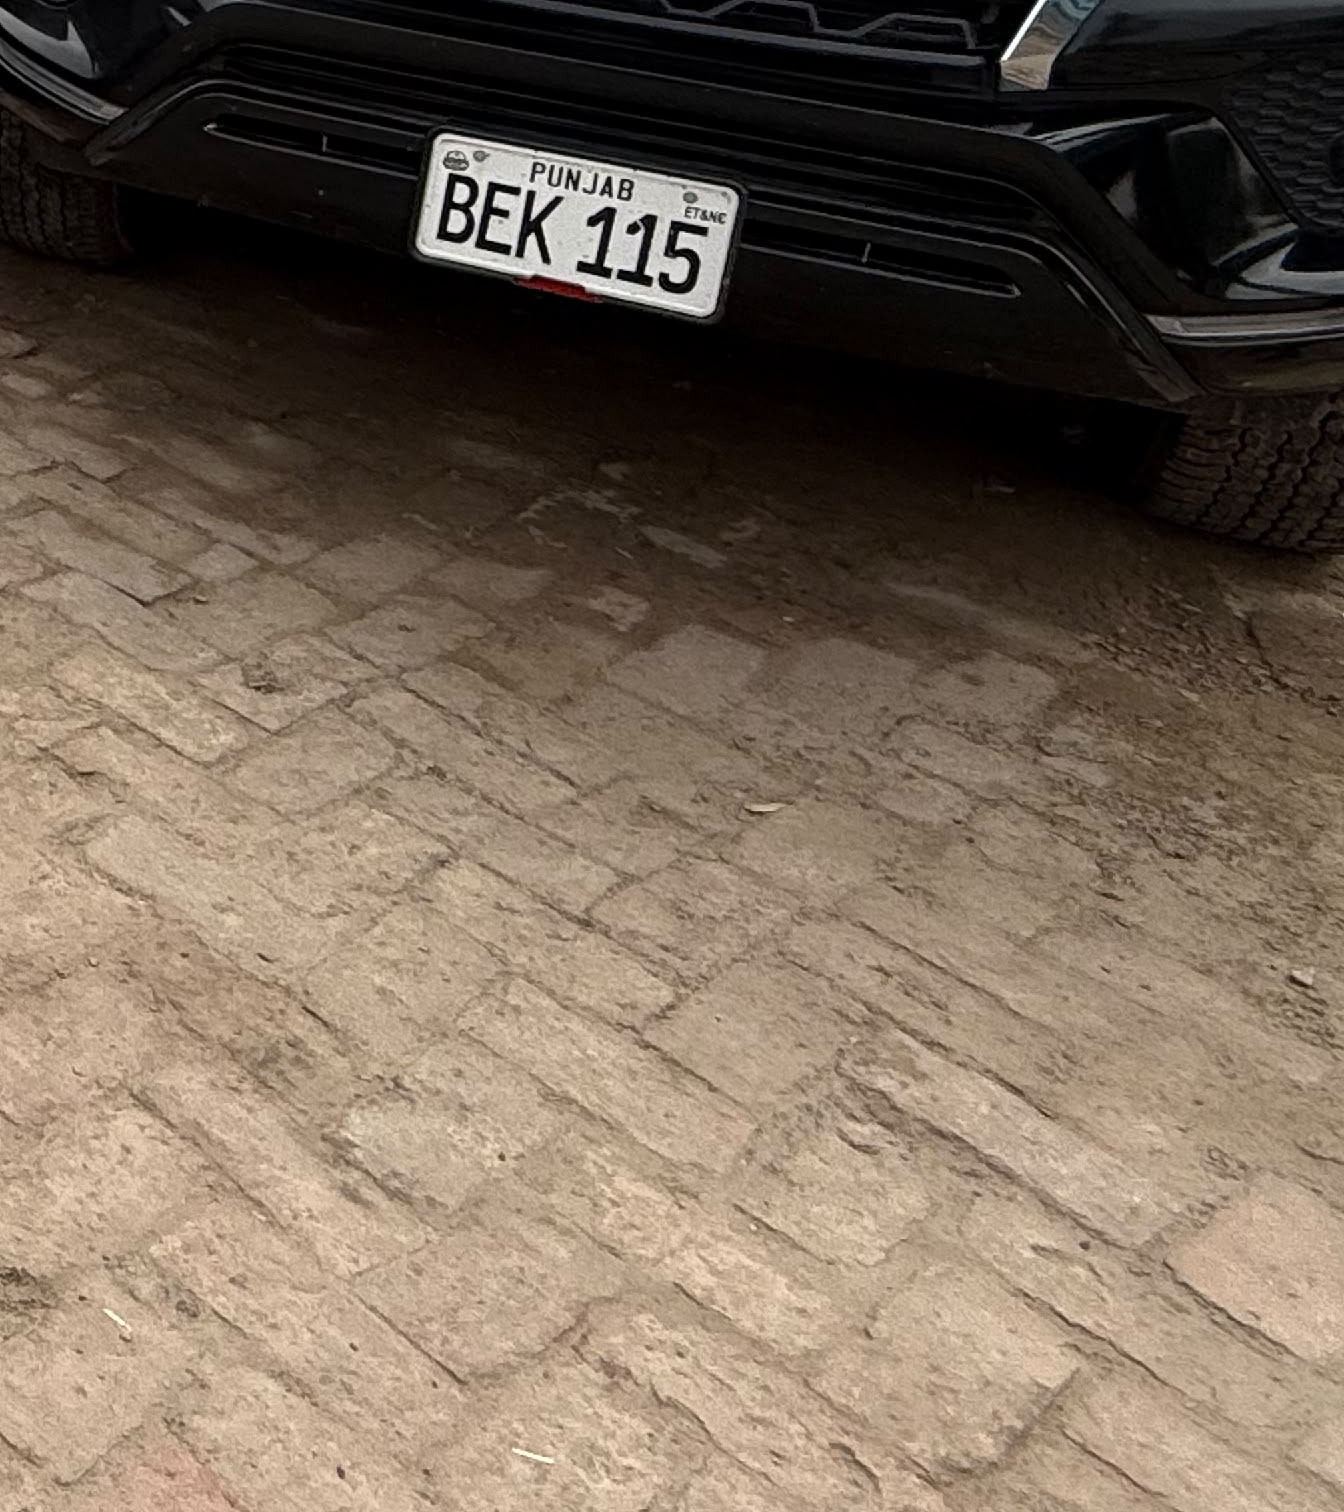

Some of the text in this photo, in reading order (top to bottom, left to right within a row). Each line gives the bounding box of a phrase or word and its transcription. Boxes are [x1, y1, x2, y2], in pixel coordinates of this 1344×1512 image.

[528, 161, 636, 202] PUNJAB
[435, 172, 710, 295] BEK 115
